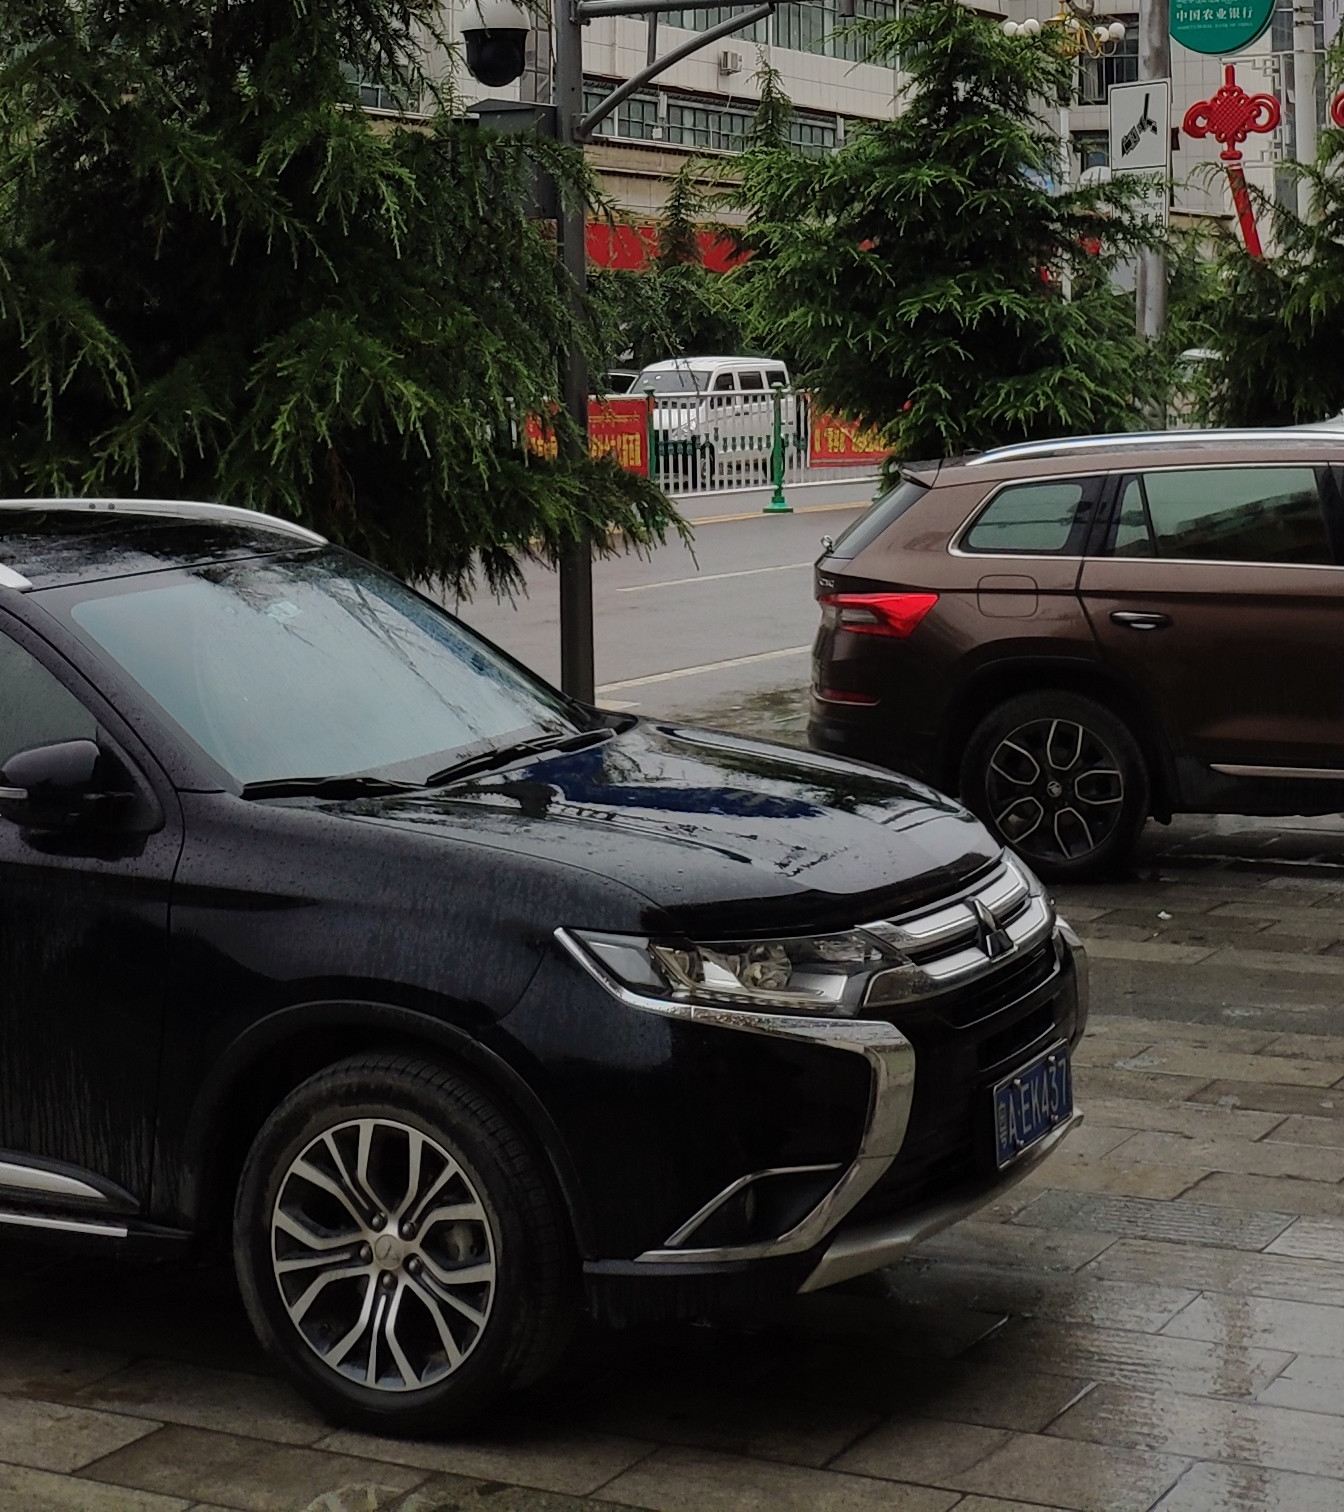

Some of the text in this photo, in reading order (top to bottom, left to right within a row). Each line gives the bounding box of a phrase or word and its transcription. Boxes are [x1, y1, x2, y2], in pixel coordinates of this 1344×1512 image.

[1176, 7, 1253, 22] 中国农业银行
